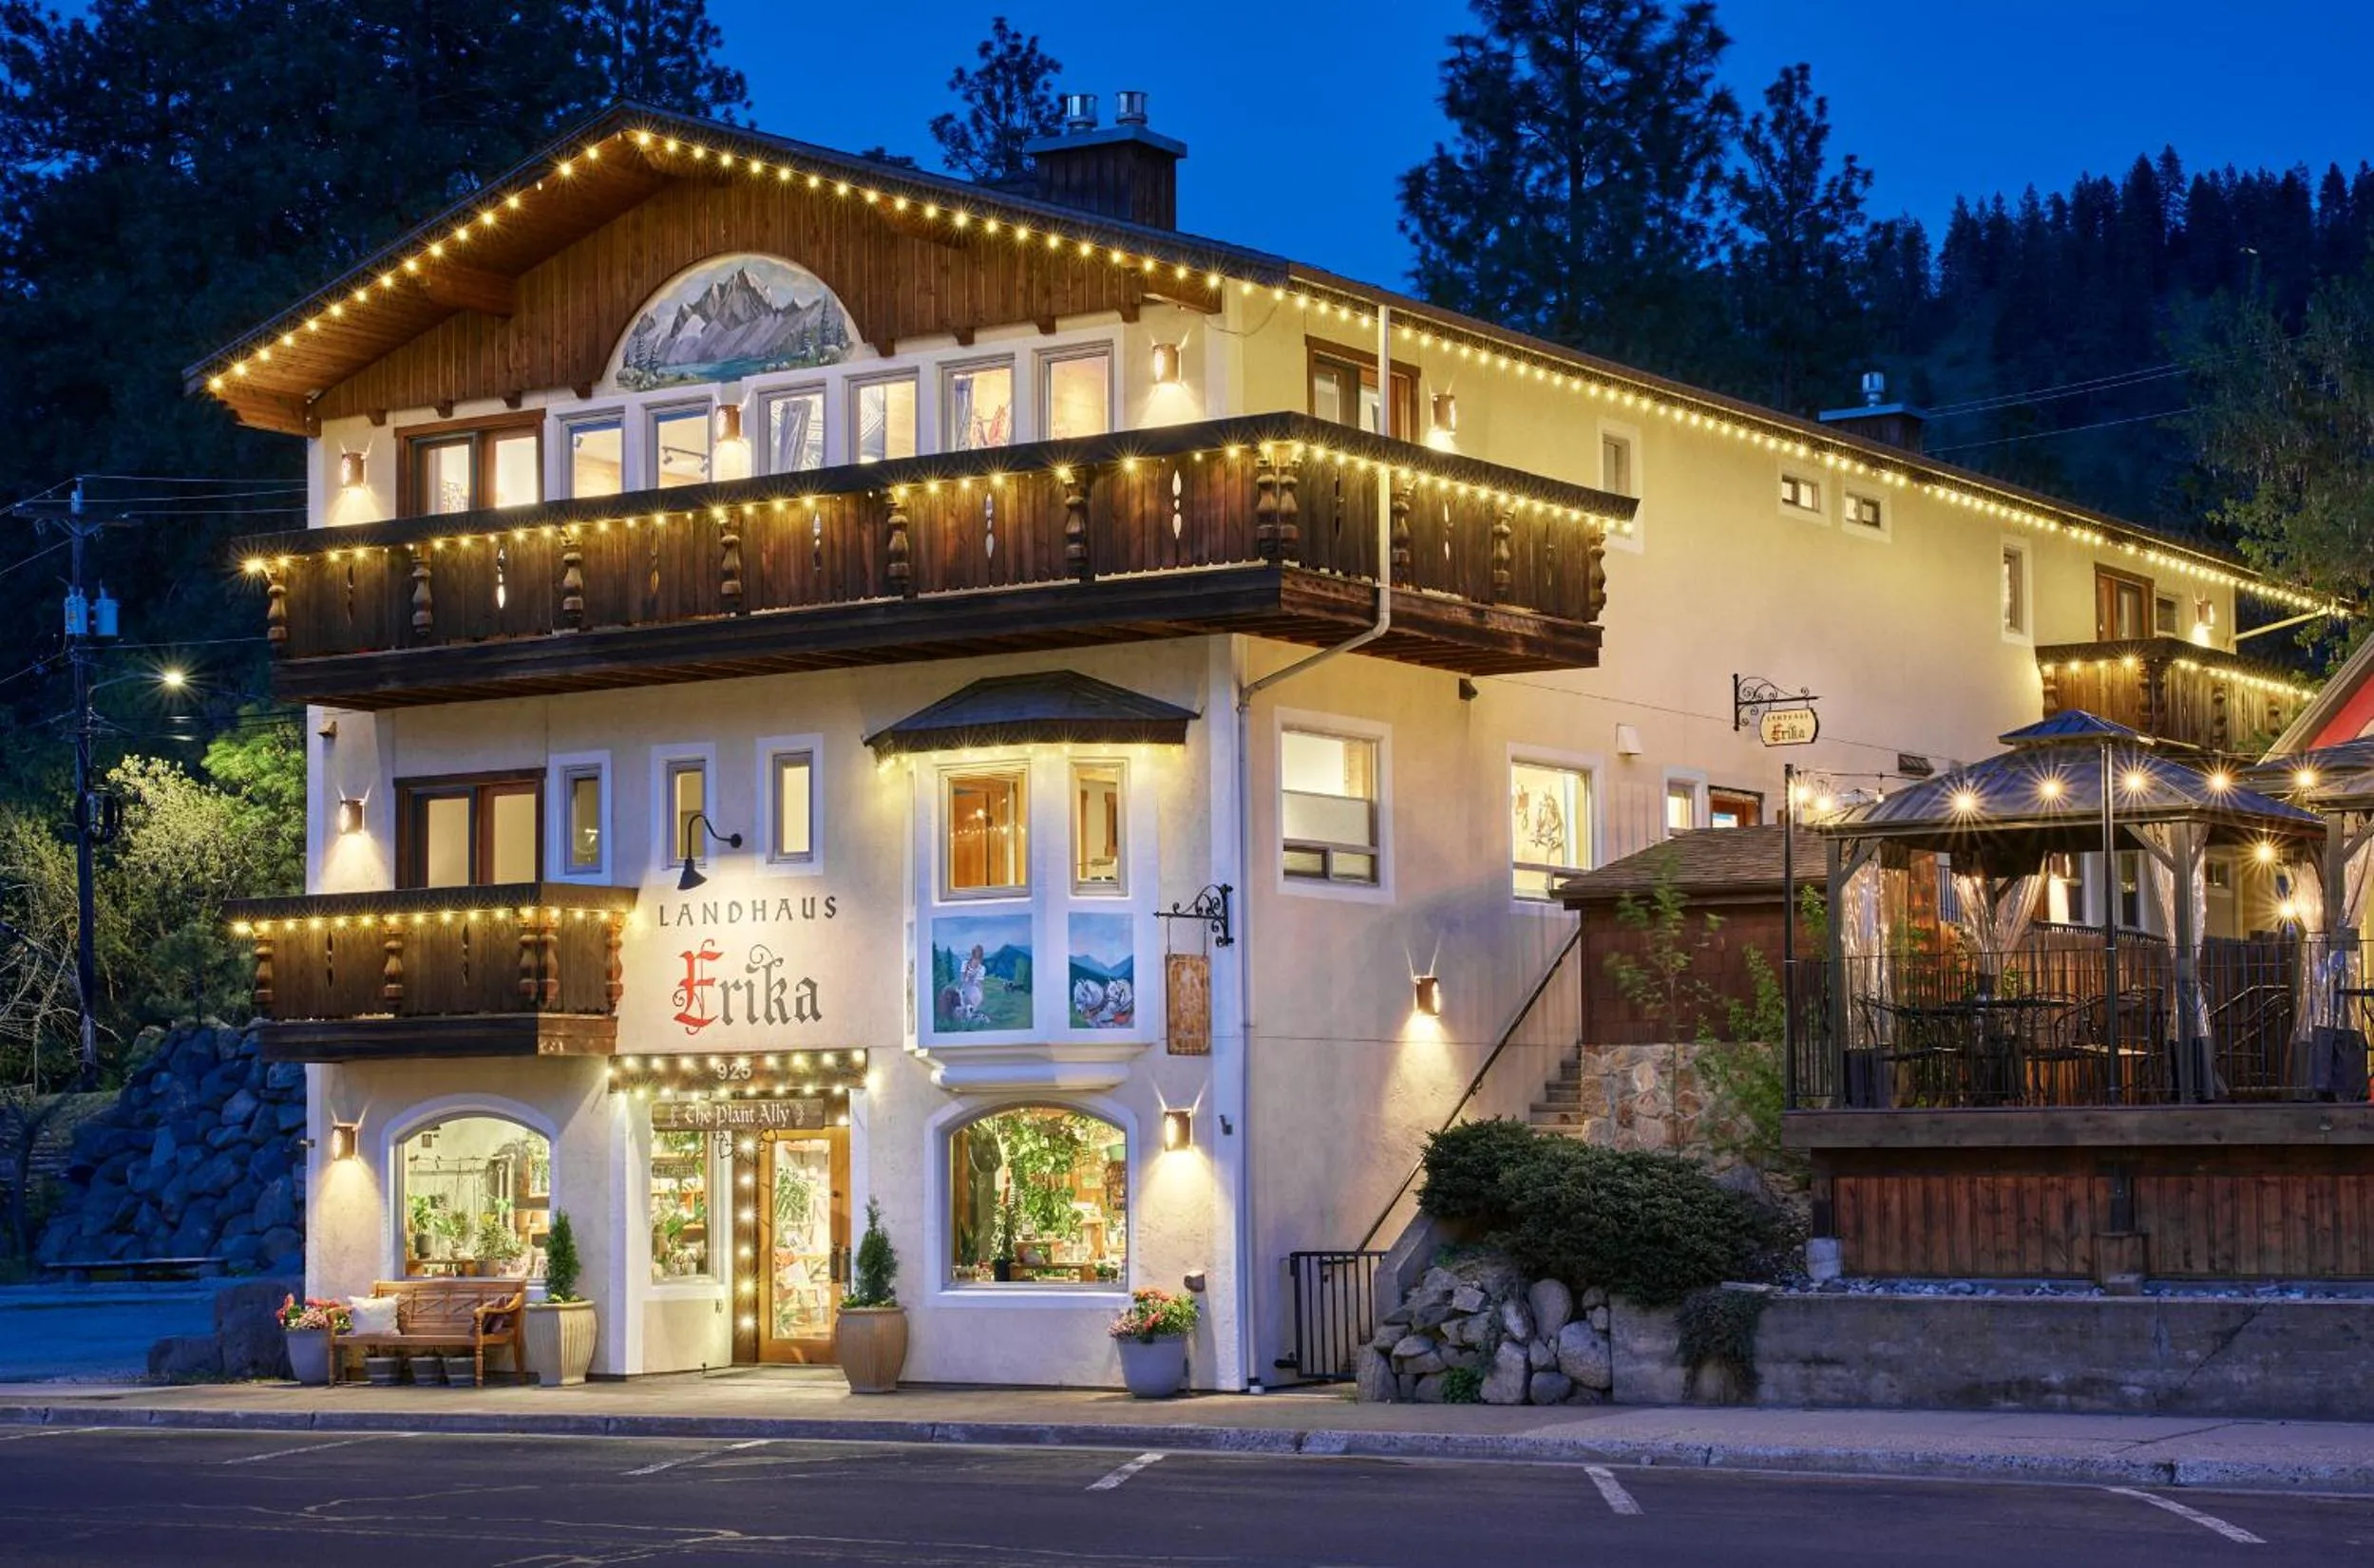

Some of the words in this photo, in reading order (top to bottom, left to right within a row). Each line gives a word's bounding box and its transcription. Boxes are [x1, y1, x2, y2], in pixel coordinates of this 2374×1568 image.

[658, 896, 837, 927] LANDHAUS
[673, 938, 823, 1035] Erika
[716, 1063, 751, 1080] 925
[684, 1104, 712, 1127] The
[715, 1104, 755, 1127] Plant
[758, 1102, 790, 1128] Ally
